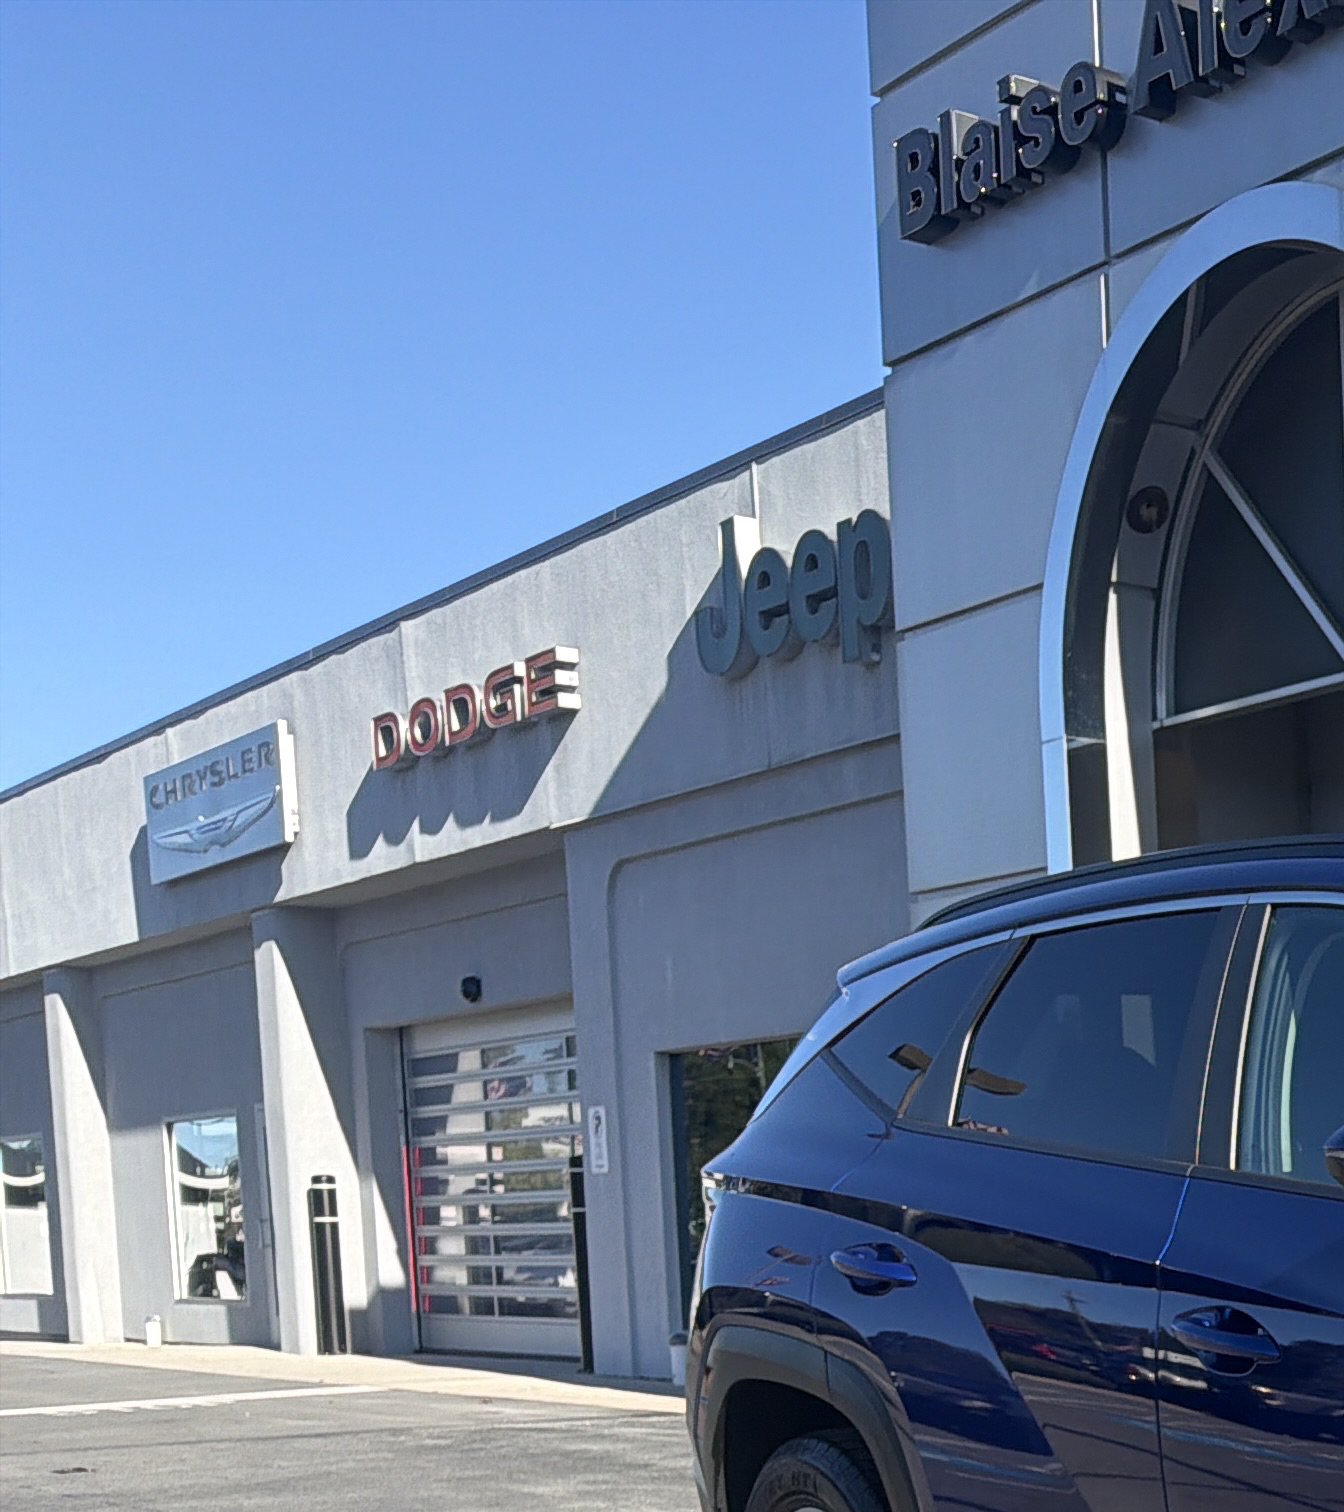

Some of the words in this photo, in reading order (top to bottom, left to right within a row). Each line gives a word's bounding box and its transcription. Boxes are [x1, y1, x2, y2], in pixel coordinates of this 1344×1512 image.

[893, 61, 1106, 242] Blaise
[694, 508, 895, 677] Jeep
[148, 739, 276, 811] CHRYSLER
[369, 645, 582, 771] DODGE
